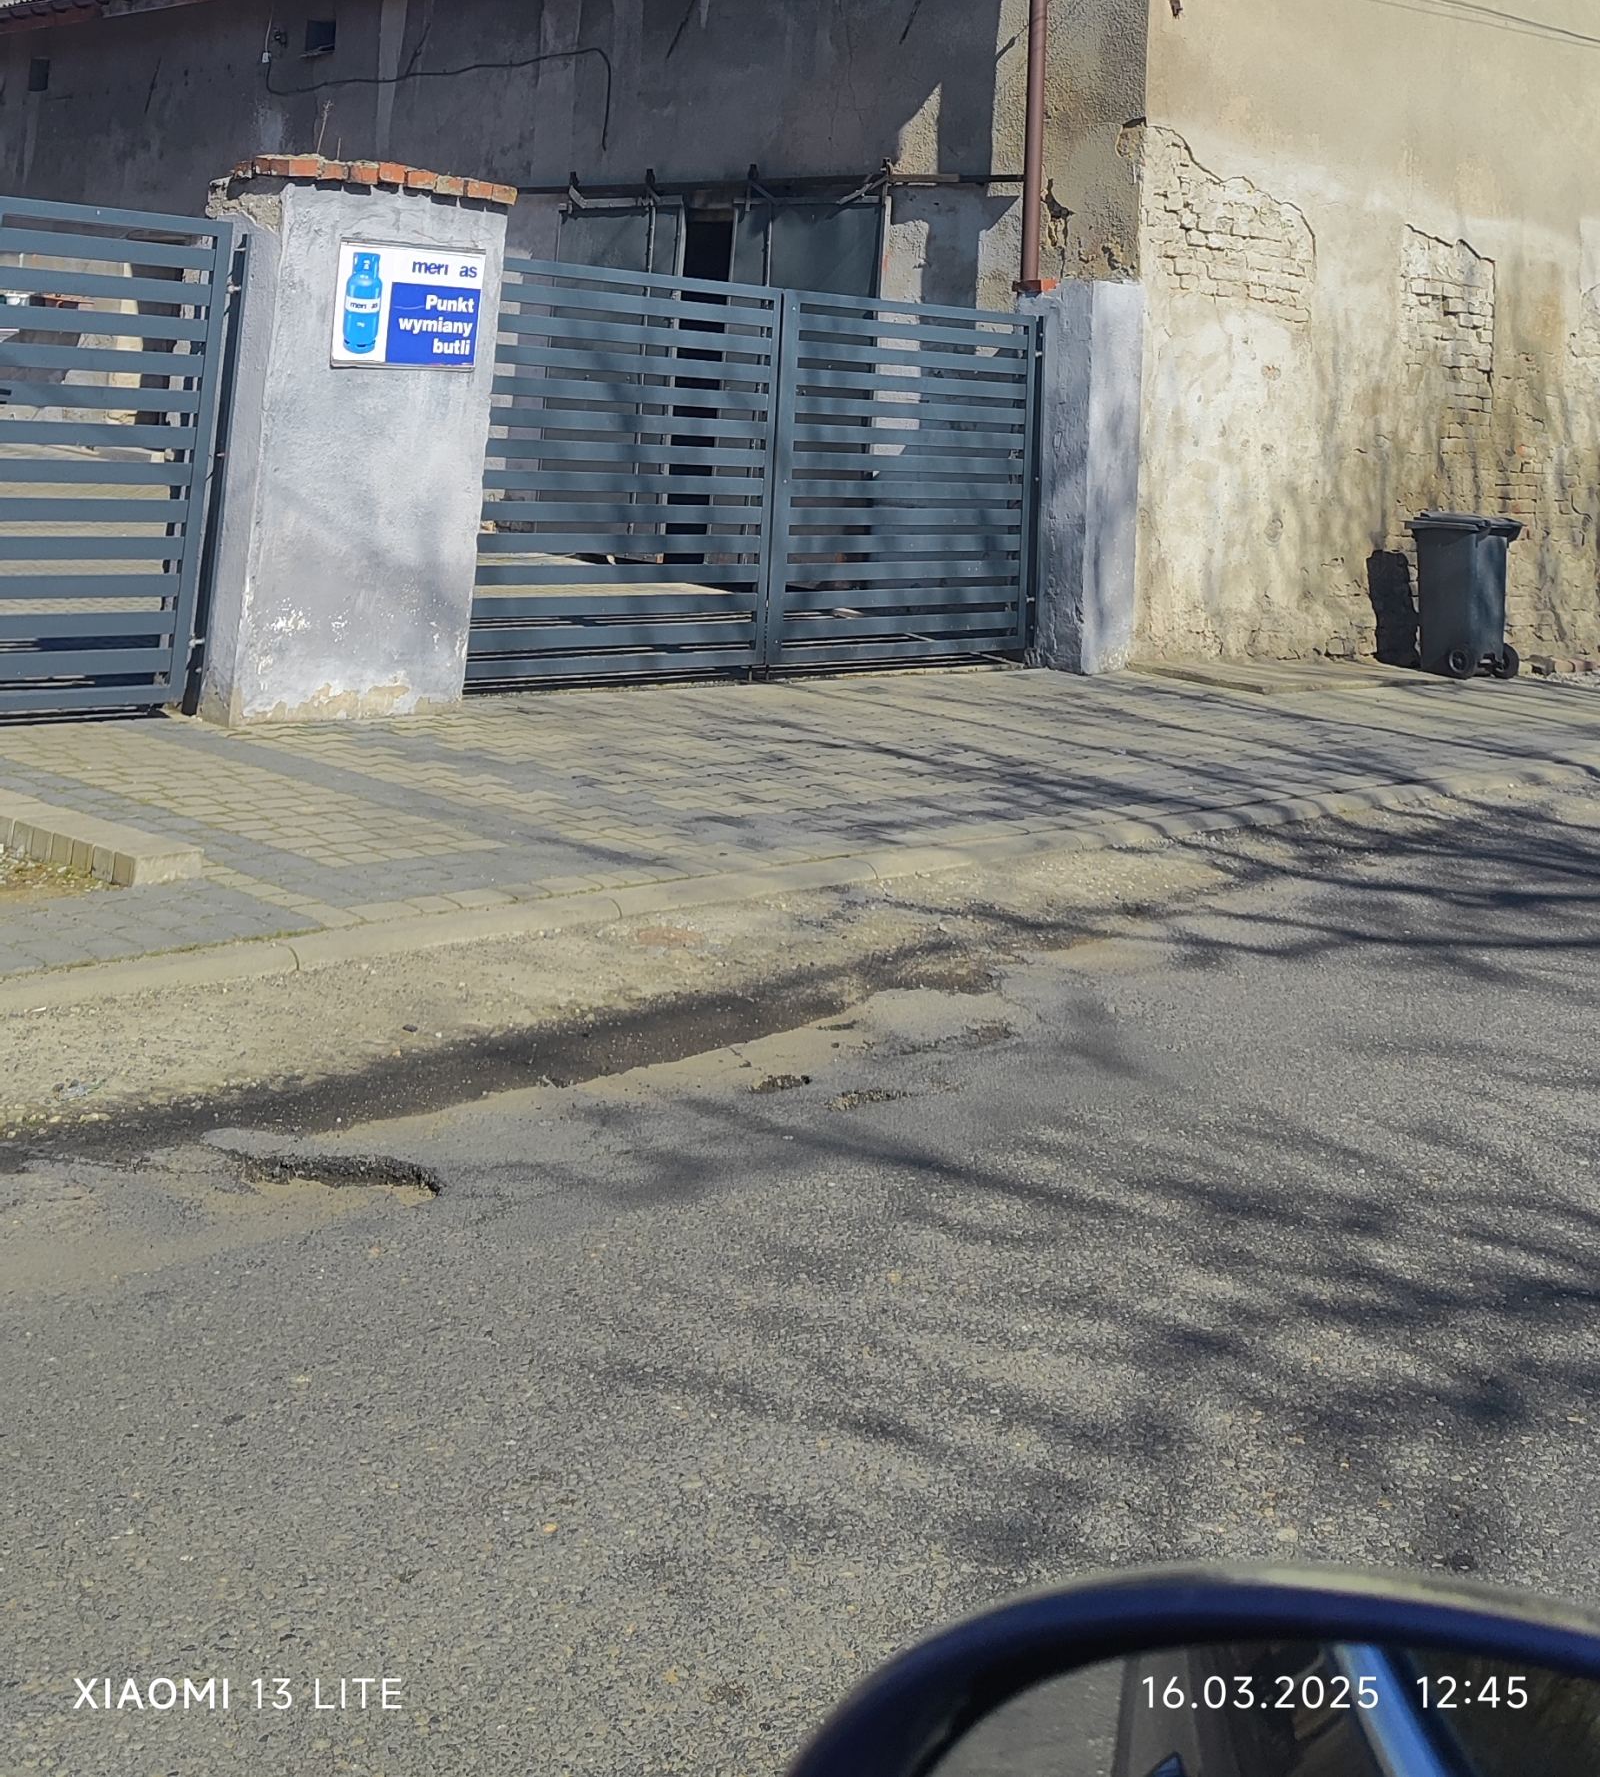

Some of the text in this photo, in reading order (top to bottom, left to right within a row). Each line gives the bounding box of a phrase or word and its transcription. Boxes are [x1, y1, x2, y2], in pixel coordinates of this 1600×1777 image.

[425, 294, 475, 313] Punkt
[399, 317, 473, 337] wymiany
[433, 338, 471, 355] butli
